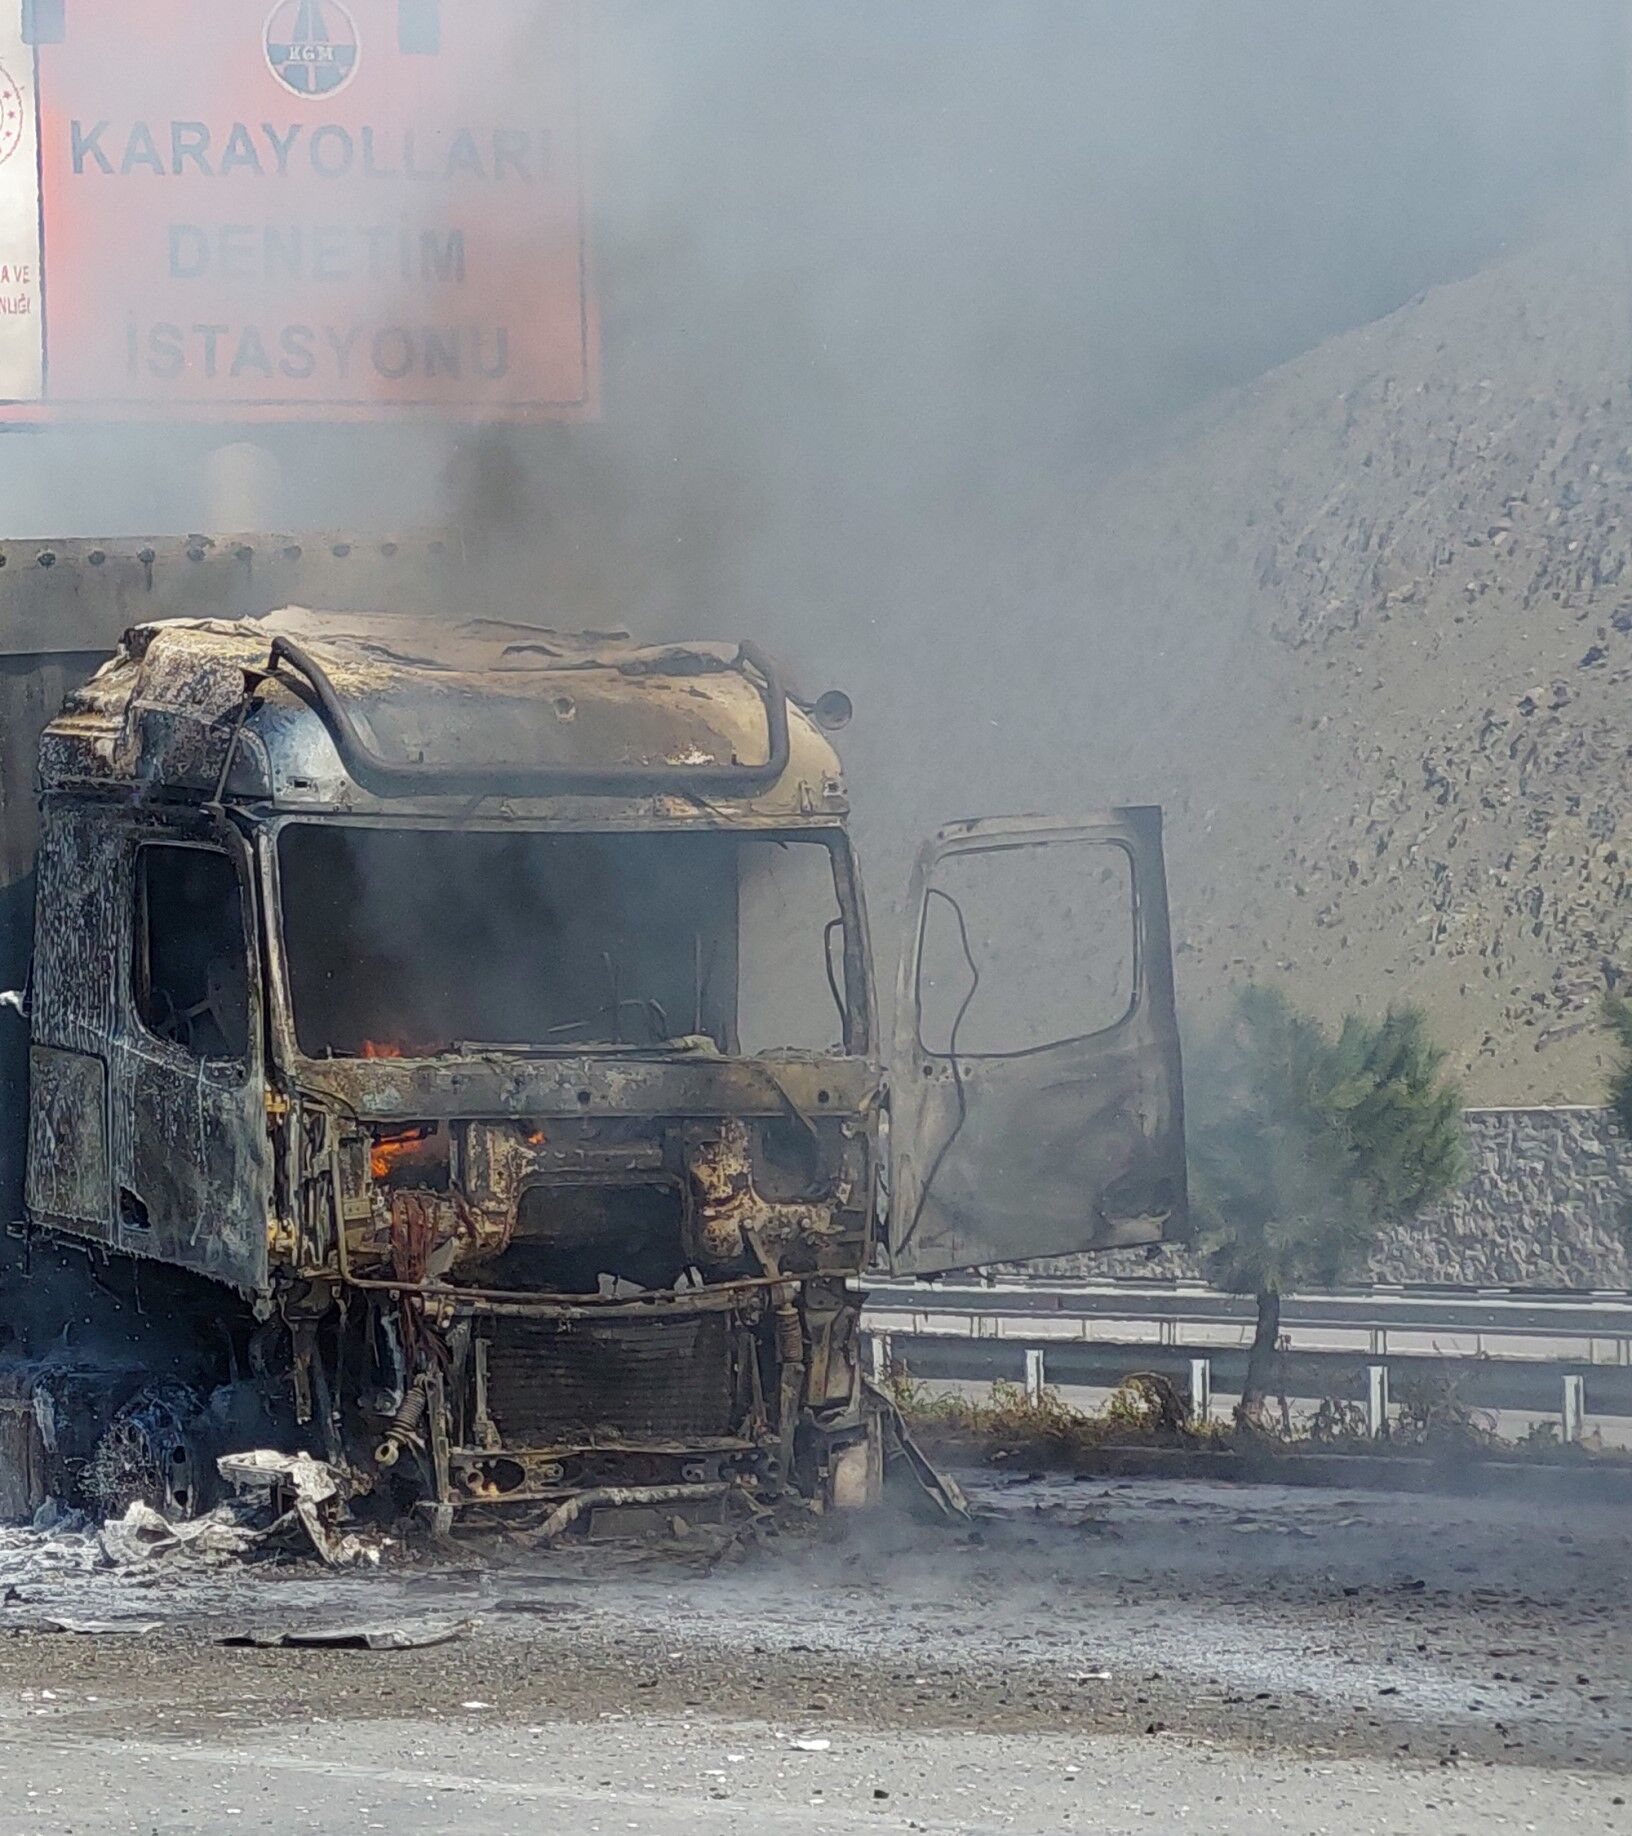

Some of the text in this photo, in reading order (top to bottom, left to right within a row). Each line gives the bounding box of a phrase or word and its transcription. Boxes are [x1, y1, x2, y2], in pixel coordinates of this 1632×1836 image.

[289, 44, 334, 62] KGM
[69, 119, 553, 182] KARAYOLLARI
[12, 264, 31, 284] VE
